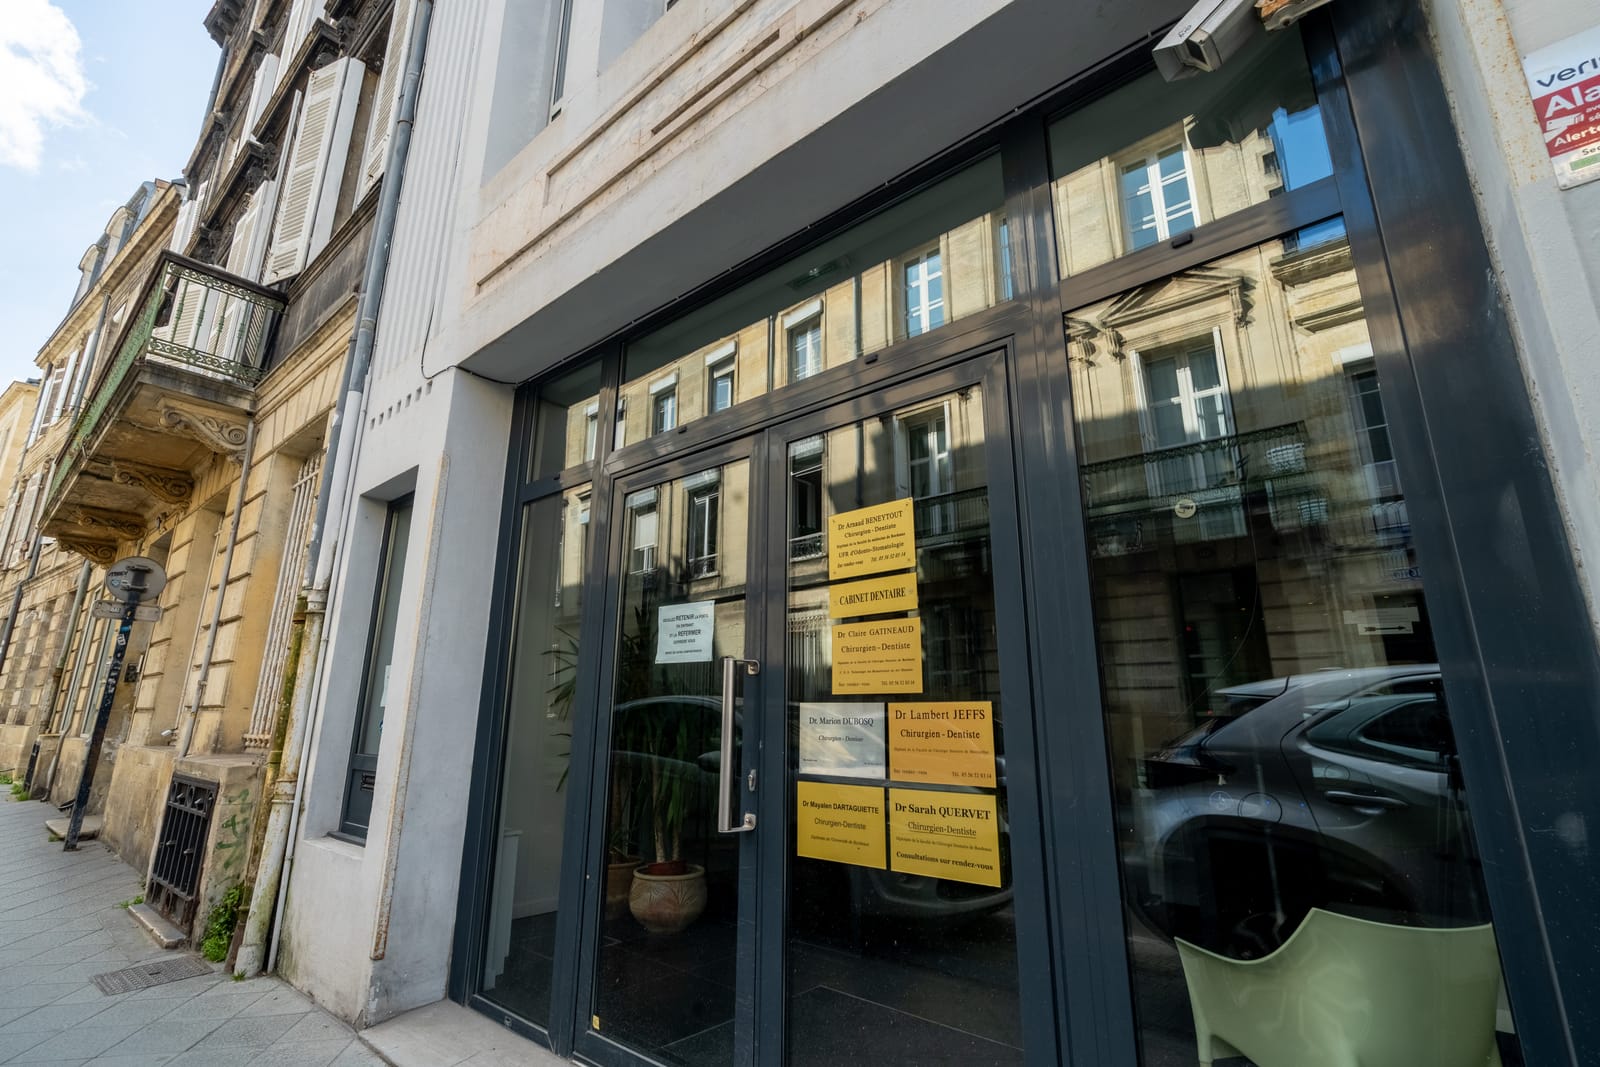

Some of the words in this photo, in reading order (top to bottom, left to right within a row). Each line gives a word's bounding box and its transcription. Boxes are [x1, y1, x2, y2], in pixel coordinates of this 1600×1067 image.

[1536, 57, 1600, 87] veri
[846, 520, 864, 528] Arnaud
[866, 511, 903, 524] BENEYTOUT
[844, 529, 871, 538] Chirurgien
[875, 524, 896, 532] Dentiste
[840, 592, 869, 605] CABINET
[870, 587, 906, 601] DENTAIRE
[869, 626, 914, 635] GATINEAUD
[882, 642, 910, 650] Dentiste
[895, 710, 906, 719] Dr
[911, 710, 949, 719] Lambert
[953, 710, 985, 719] JEFFS
[842, 718, 874, 727] DUBOSQ
[900, 729, 940, 739] Chirurgien
[947, 730, 980, 739] Dentiste
[896, 803, 907, 812] Dr
[908, 804, 936, 814] Sarah
[939, 807, 991, 820] QUERVET
[908, 822, 976, 836] Chirurgien-Dentiste
[896, 851, 939, 863] Consultations
[952, 860, 993, 870] rendez-vous
